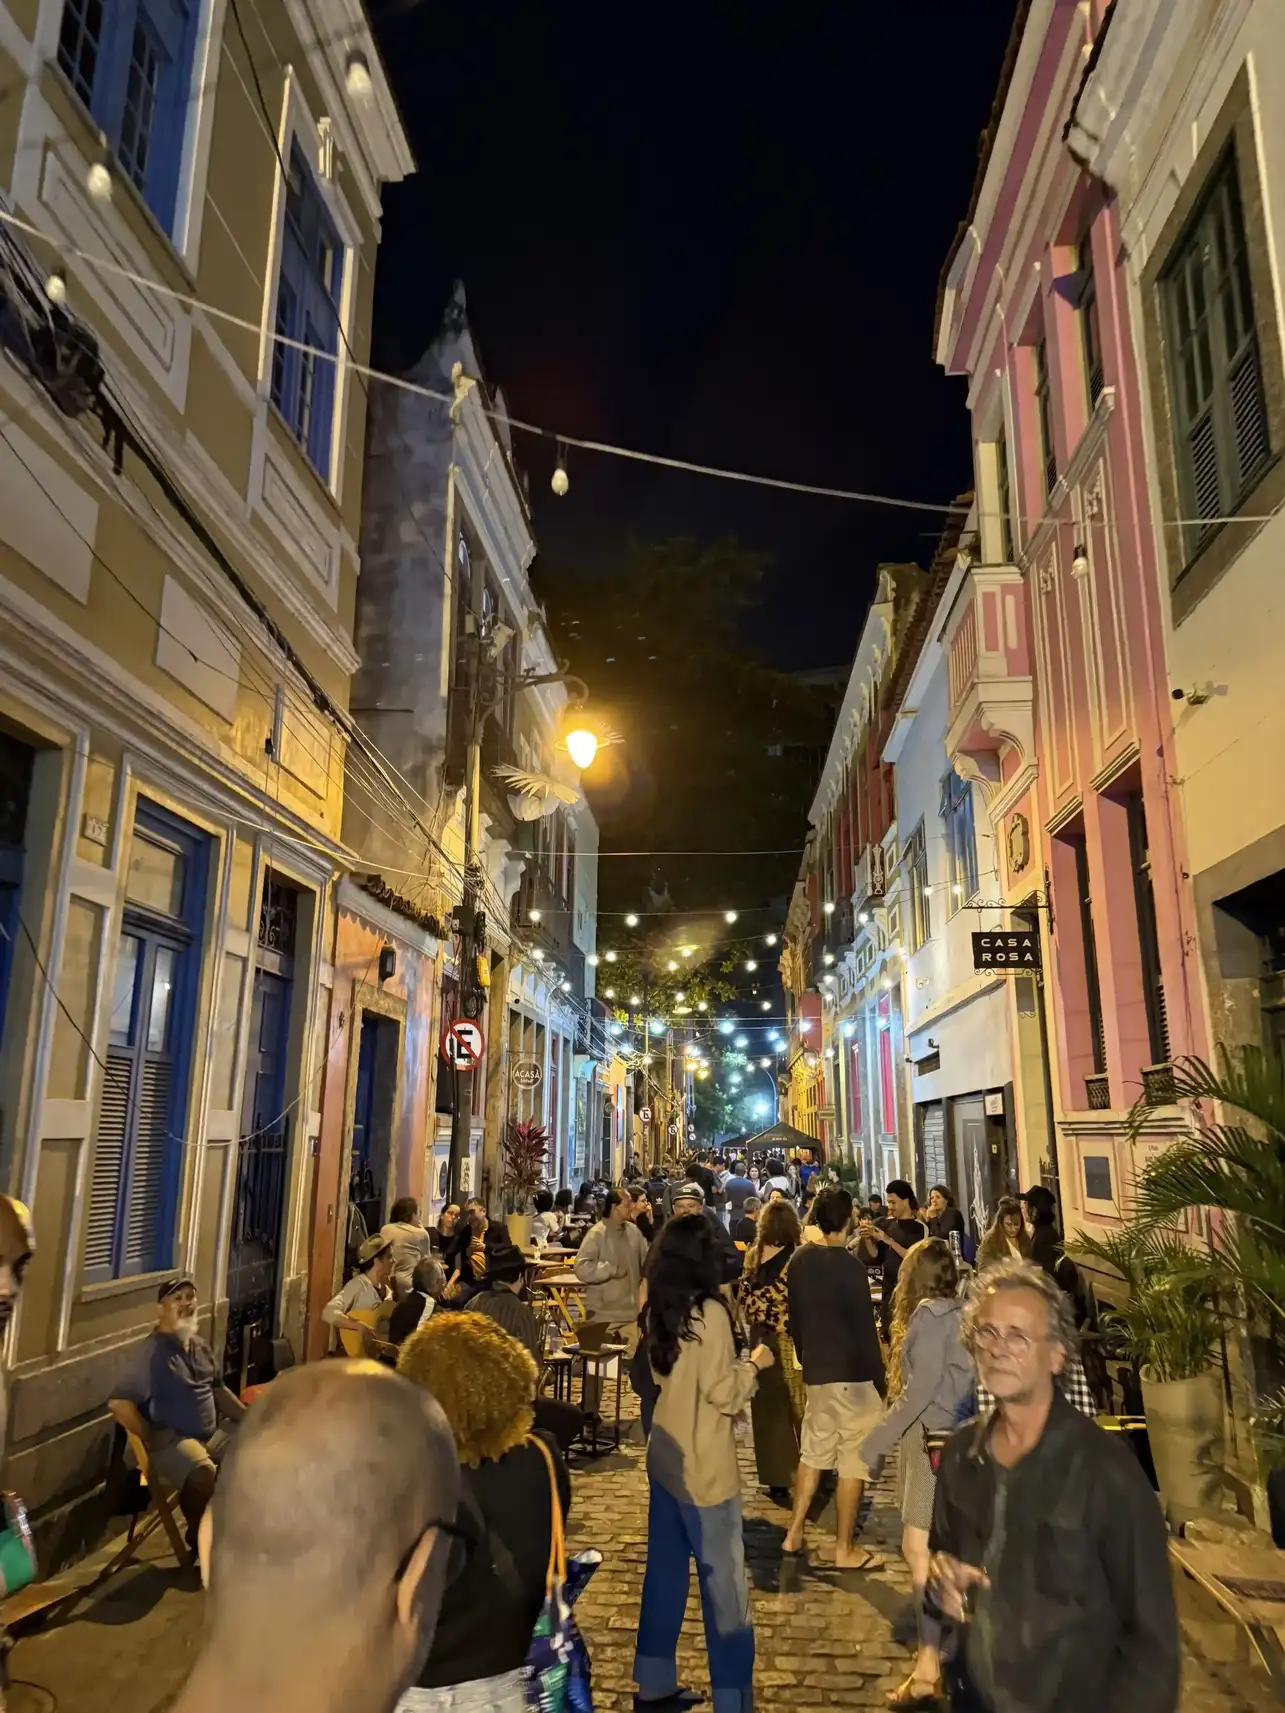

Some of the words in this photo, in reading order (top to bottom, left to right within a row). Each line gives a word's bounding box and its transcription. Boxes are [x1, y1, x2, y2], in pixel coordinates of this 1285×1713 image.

[981, 938, 1032, 947] CASA
[982, 952, 1033, 962] ROSA
[457, 1030, 473, 1058] E
